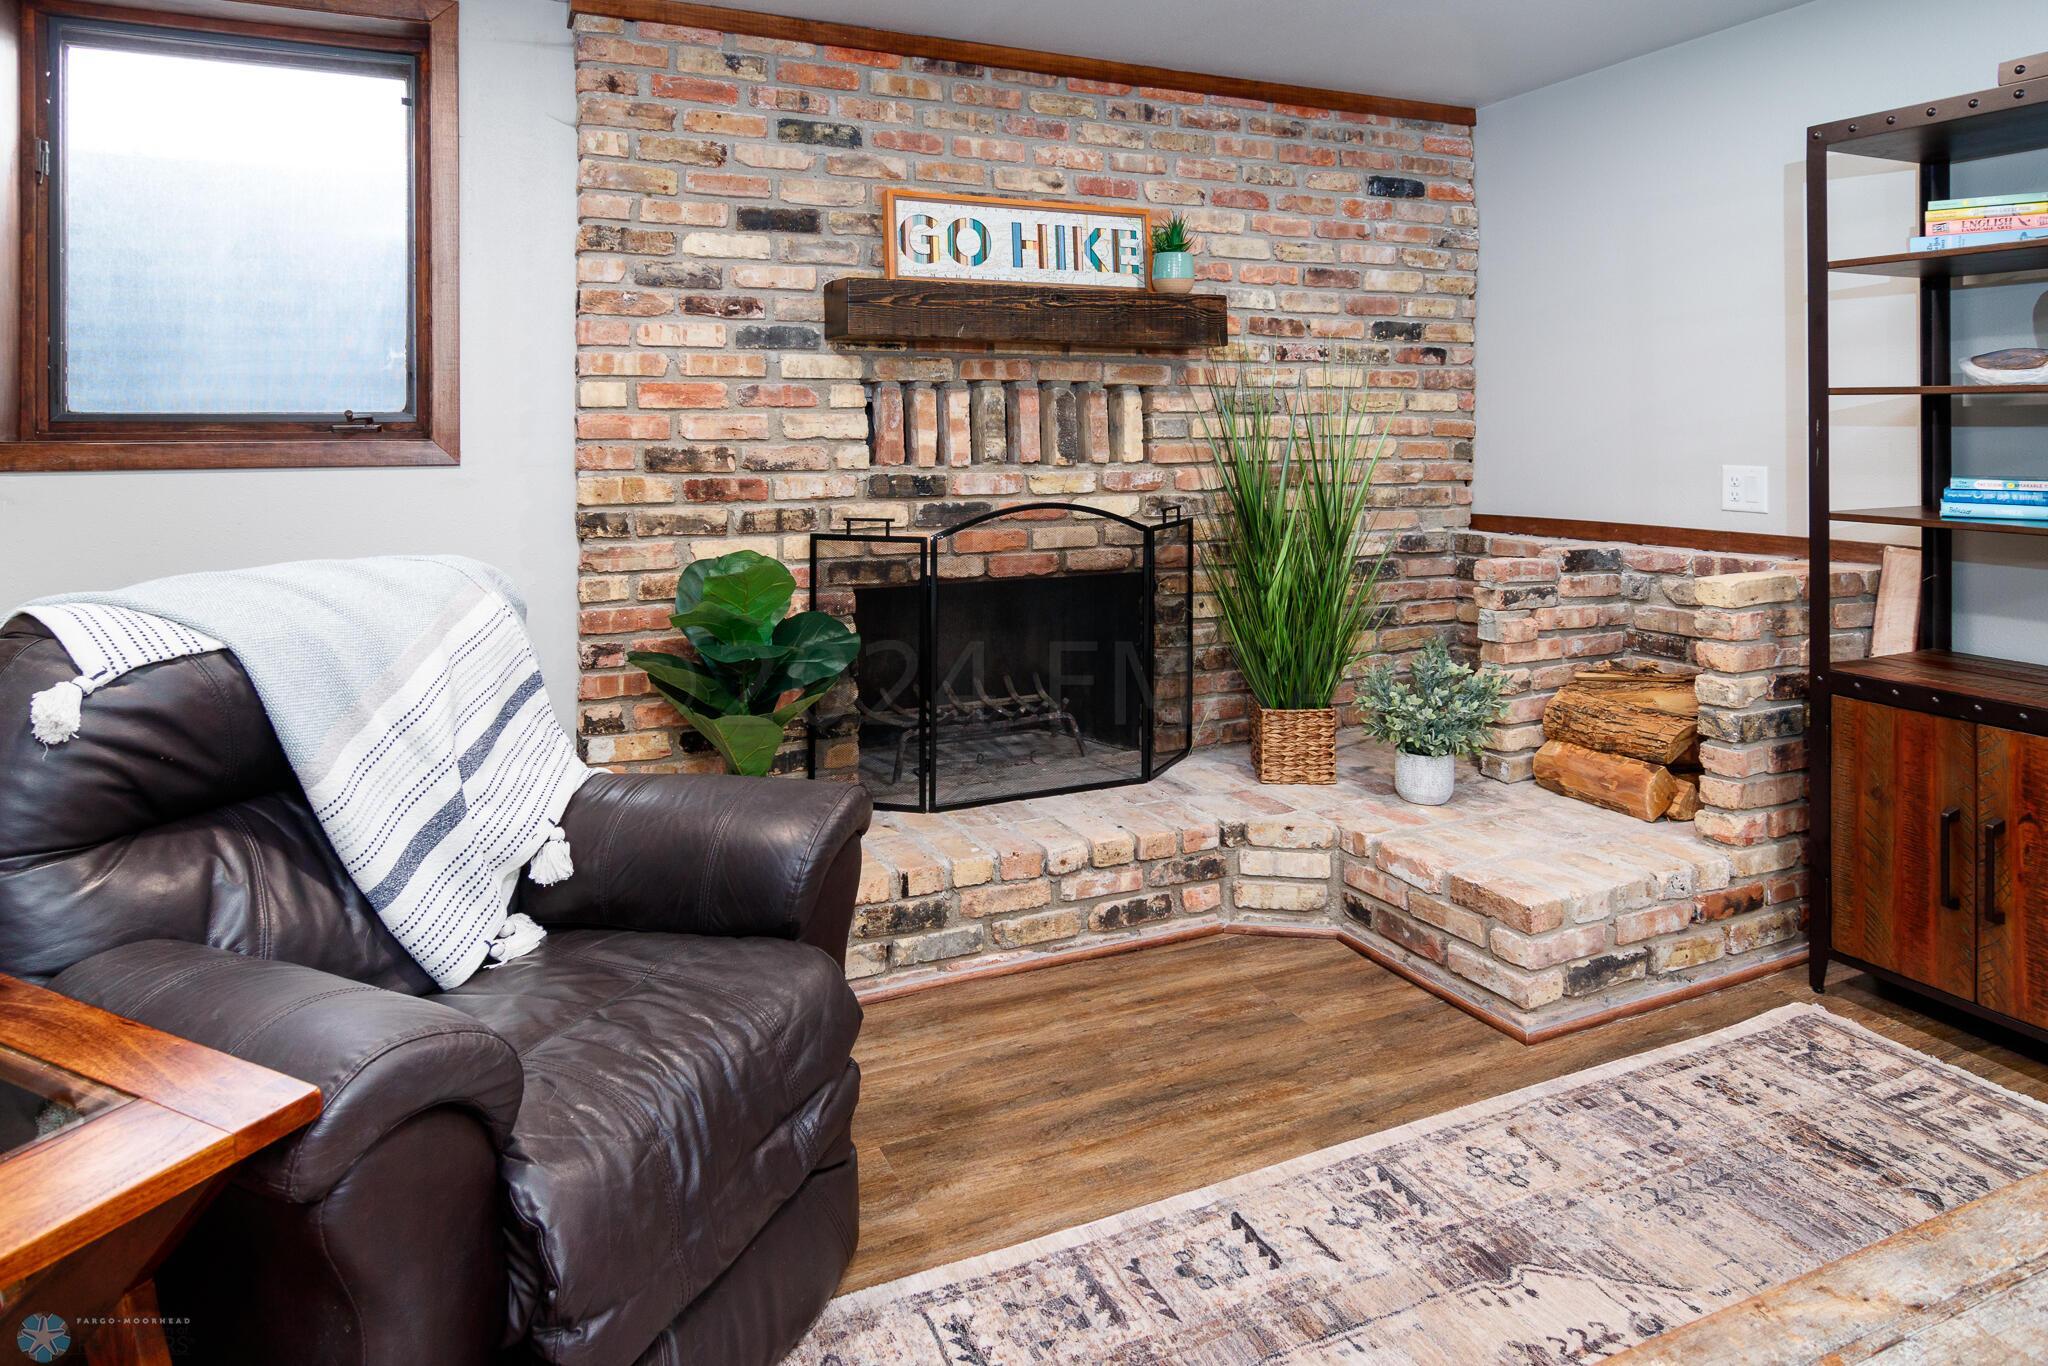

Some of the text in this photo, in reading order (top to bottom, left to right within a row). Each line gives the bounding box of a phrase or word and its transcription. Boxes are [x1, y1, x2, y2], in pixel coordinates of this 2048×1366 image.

[1961, 217, 2013, 228] ENGLISH
[899, 213, 1140, 275] GO HIKE
